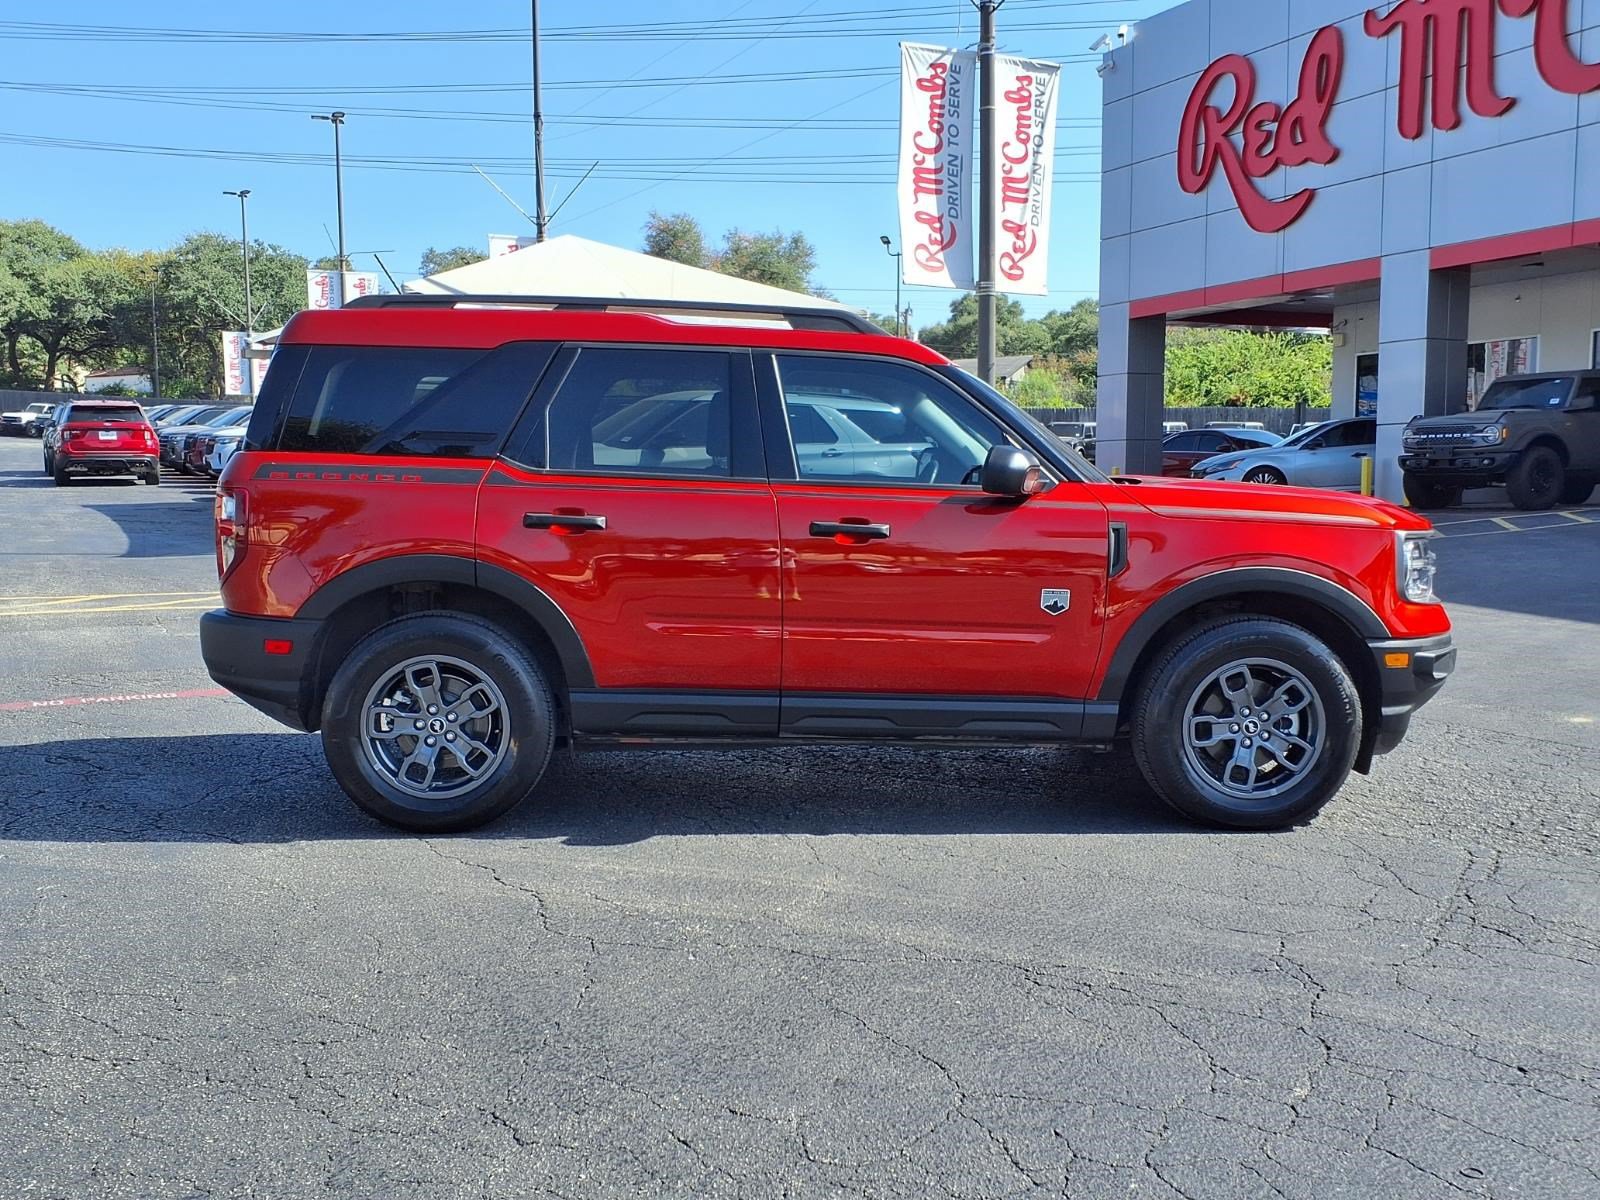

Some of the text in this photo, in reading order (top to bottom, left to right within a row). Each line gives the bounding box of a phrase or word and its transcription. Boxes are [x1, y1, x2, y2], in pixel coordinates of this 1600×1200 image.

[912, 62, 957, 273] Red McCombs
[947, 63, 962, 220] DRIVEN TO SERVE
[999, 75, 1037, 281] Red McCombs
[1030, 75, 1046, 227] DRIVEN TO SERVE
[1177, 25, 1344, 233] Red
[269, 471, 422, 482] BRONCO
[80, 692, 178, 704] PARKING
